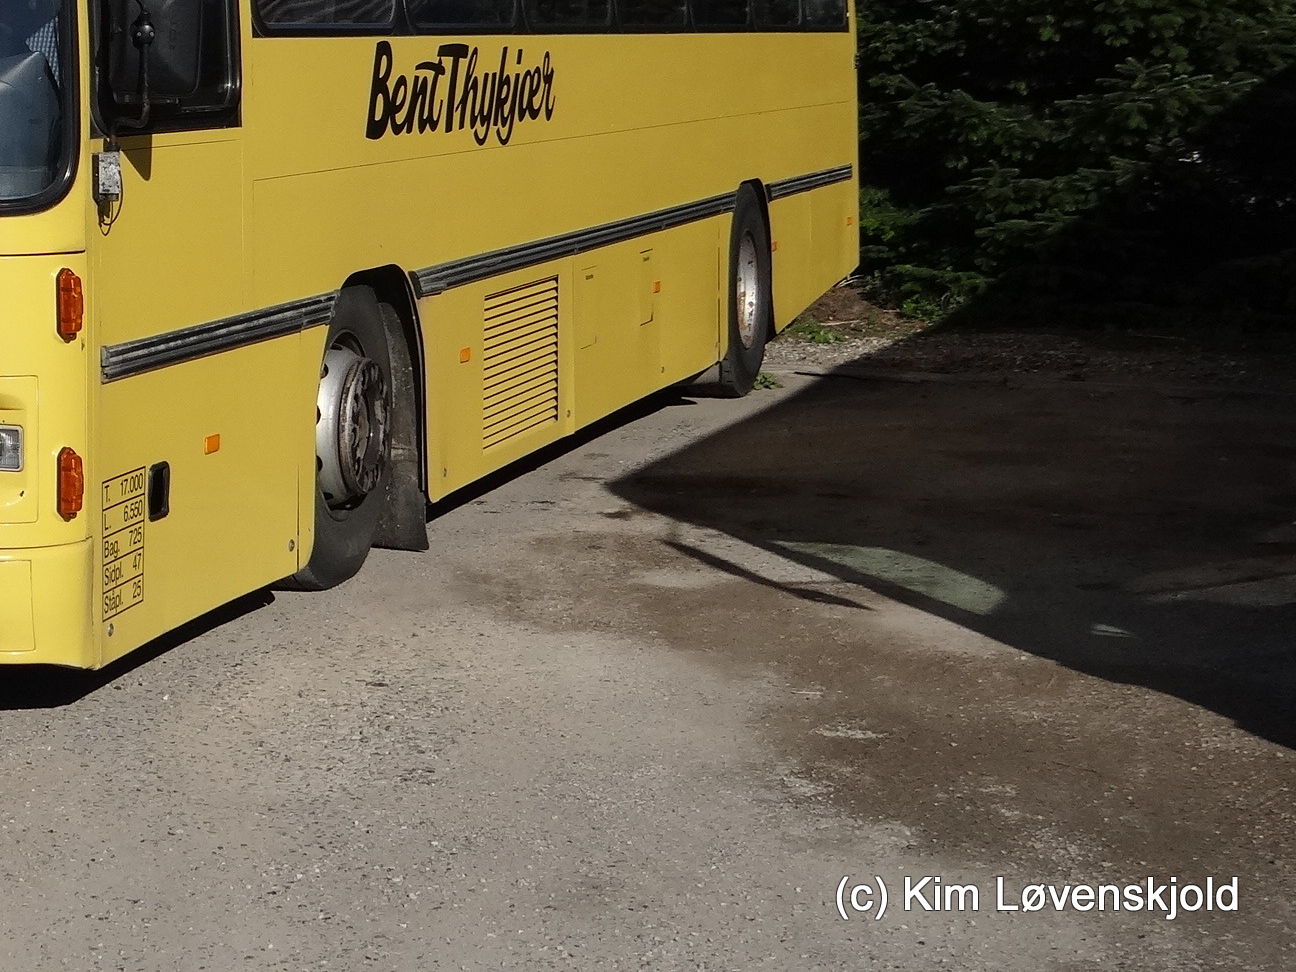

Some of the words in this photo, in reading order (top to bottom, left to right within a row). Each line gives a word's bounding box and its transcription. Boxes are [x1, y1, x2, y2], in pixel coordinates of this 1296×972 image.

[366, 40, 445, 140] Bent
[437, 43, 556, 146] Thykjær
[120, 473, 143, 496] 17.000
[123, 499, 143, 523] 6.550
[104, 539, 120, 559] Bag.
[129, 527, 142, 546] 725
[104, 562, 124, 586] Sidpl.
[133, 553, 141, 570] 47
[104, 590, 124, 614] Ståpl.
[133, 580, 141, 598] 25
